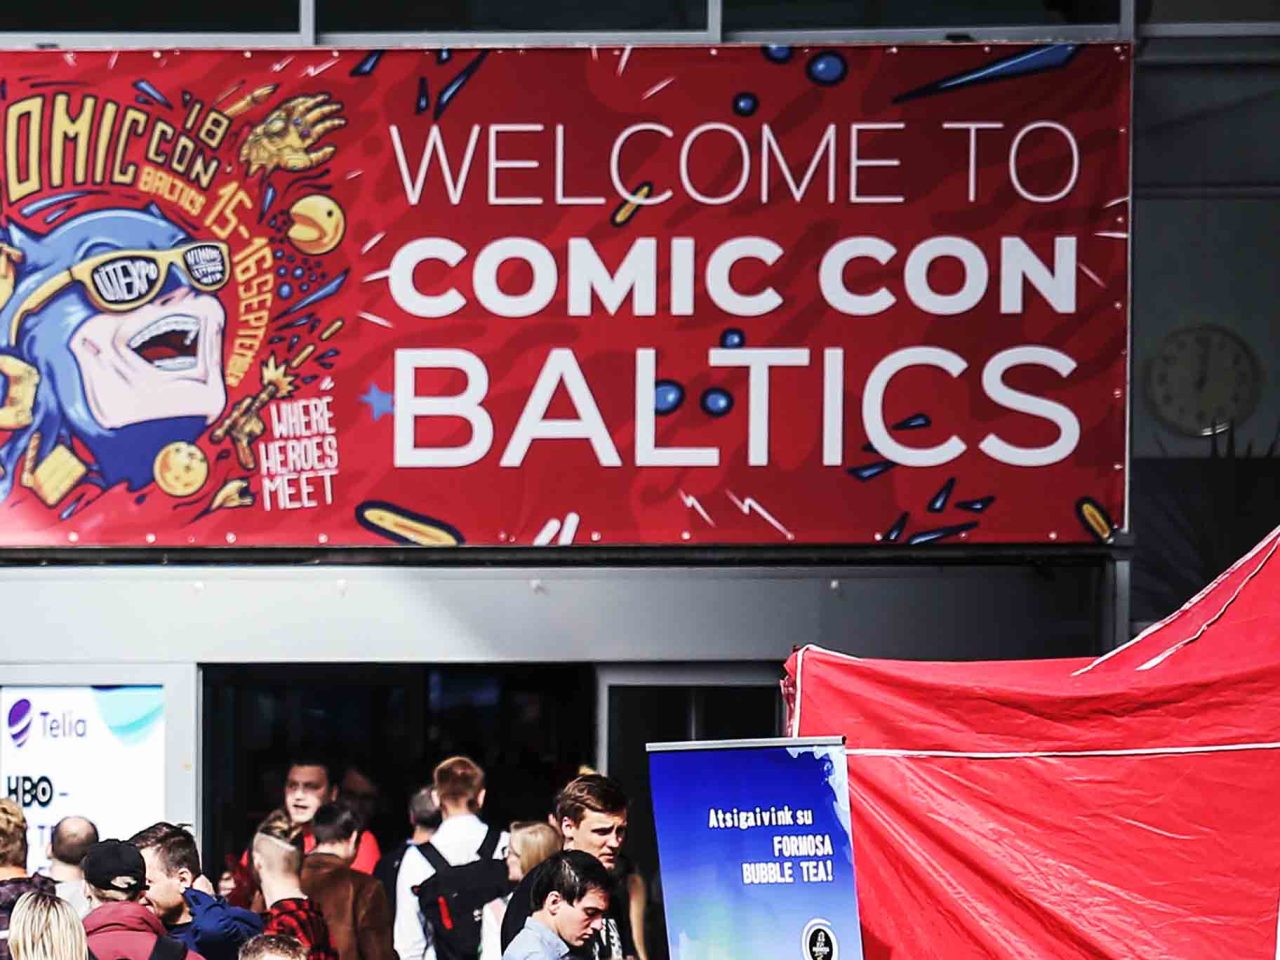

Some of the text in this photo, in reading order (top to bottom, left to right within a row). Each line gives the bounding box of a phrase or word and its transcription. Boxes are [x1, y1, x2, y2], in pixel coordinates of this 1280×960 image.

[146, 118, 220, 189] CON
[389, 121, 1081, 206] WELCOME TO
[138, 165, 207, 217] BALTICS
[388, 235, 1078, 318] COMIC CON
[270, 395, 337, 439] WHERE
[393, 346, 1081, 468] BALTICS
[258, 436, 339, 476] HEROES
[261, 469, 339, 512] MEET
[39, 711, 87, 738] Telia
[6, 776, 53, 807] HBO
[708, 804, 813, 830] Atsigaivink su
[773, 834, 834, 858] FORMOSA
[742, 859, 833, 885] BUBBLE TEA!
